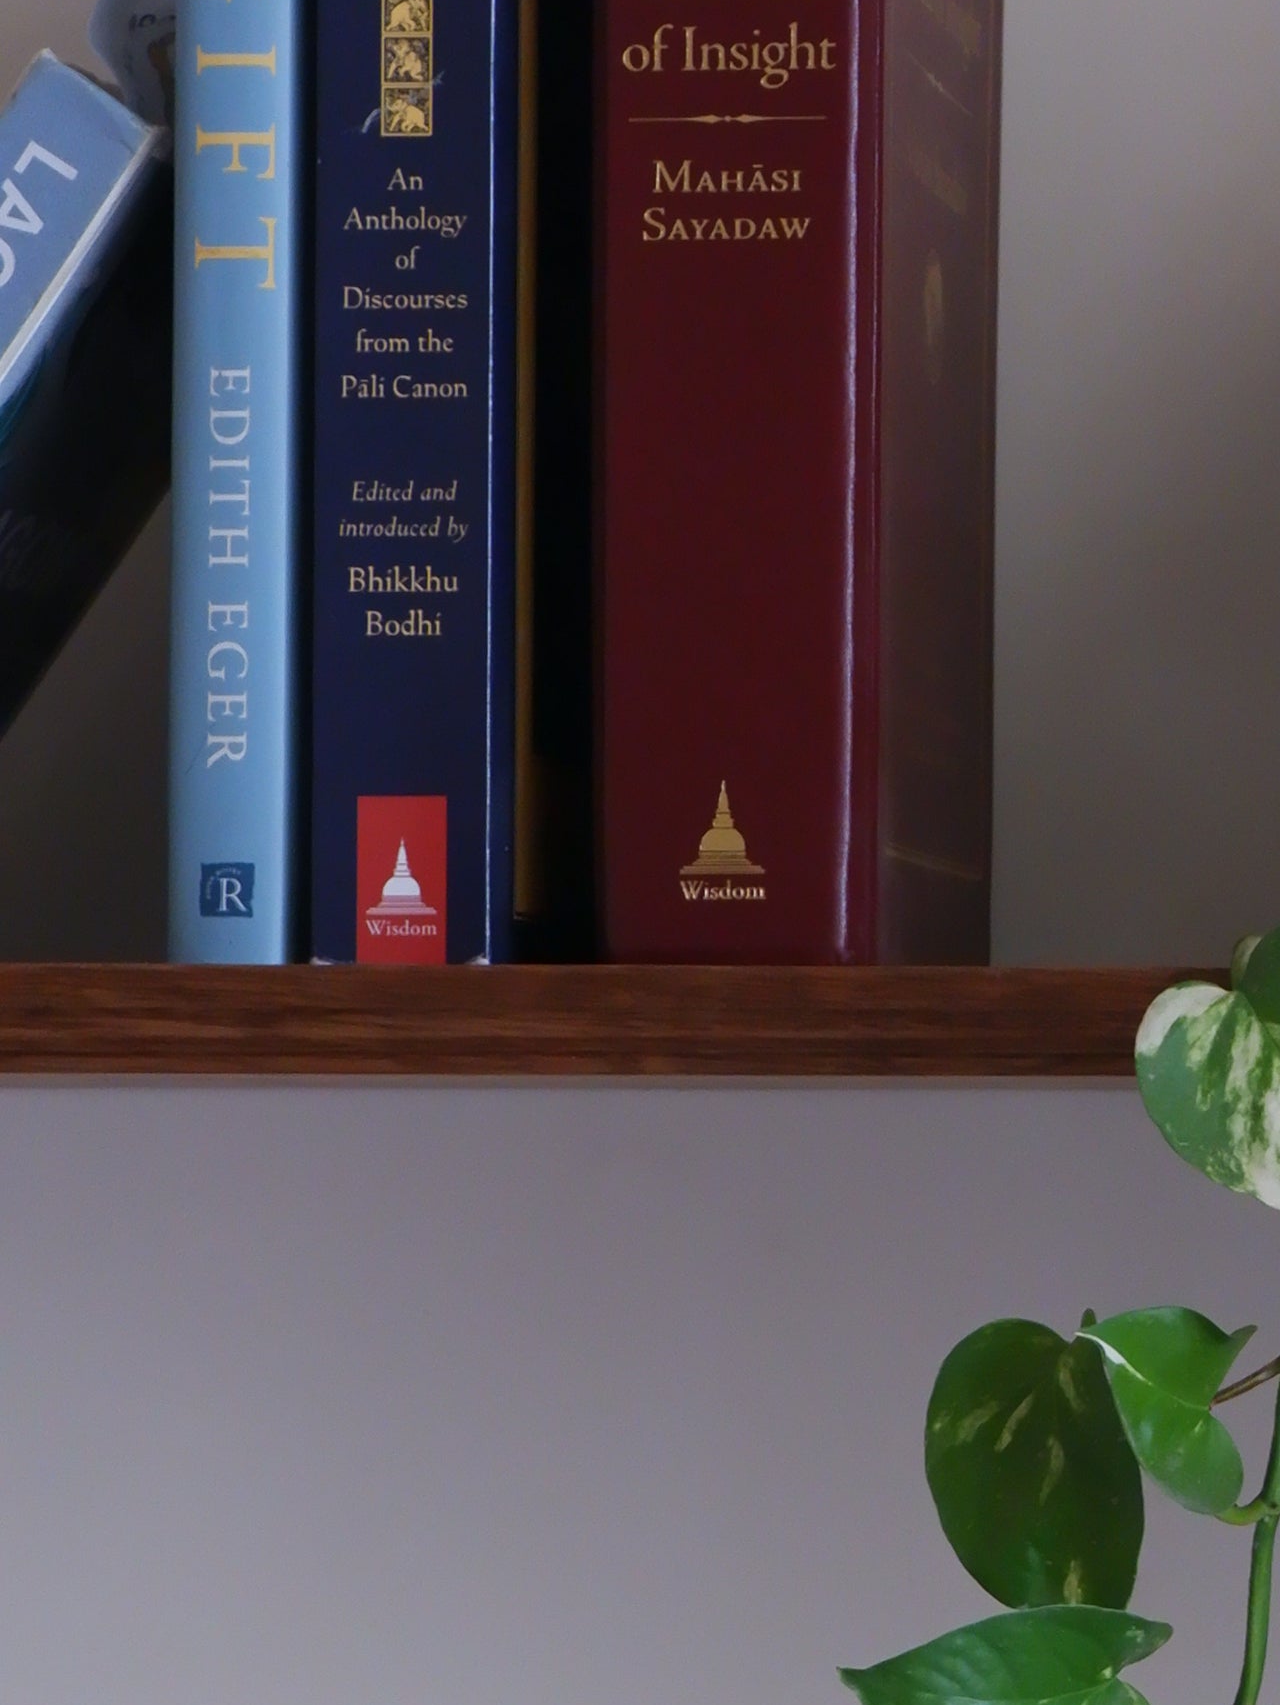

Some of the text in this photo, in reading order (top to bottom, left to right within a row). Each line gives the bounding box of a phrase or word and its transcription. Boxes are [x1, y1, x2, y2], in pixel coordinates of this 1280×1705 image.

[622, 21, 837, 89] of Insight
[387, 168, 423, 190] An
[343, 206, 467, 238] Anthology
[642, 206, 811, 242] SAYADAW
[395, 246, 420, 270] of
[343, 286, 468, 309] Discourses
[356, 329, 454, 352] from the
[341, 374, 468, 398] Pāli Canon
[352, 479, 457, 502] Edited and
[338, 515, 469, 544] introduced by
[206, 366, 251, 770] EDITH EGER
[348, 565, 459, 593] Bhikkhu
[365, 609, 442, 636] Bodhi
[217, 877, 247, 912] R
[680, 879, 766, 901] Wisdom
[366, 918, 437, 936] Wisdom
